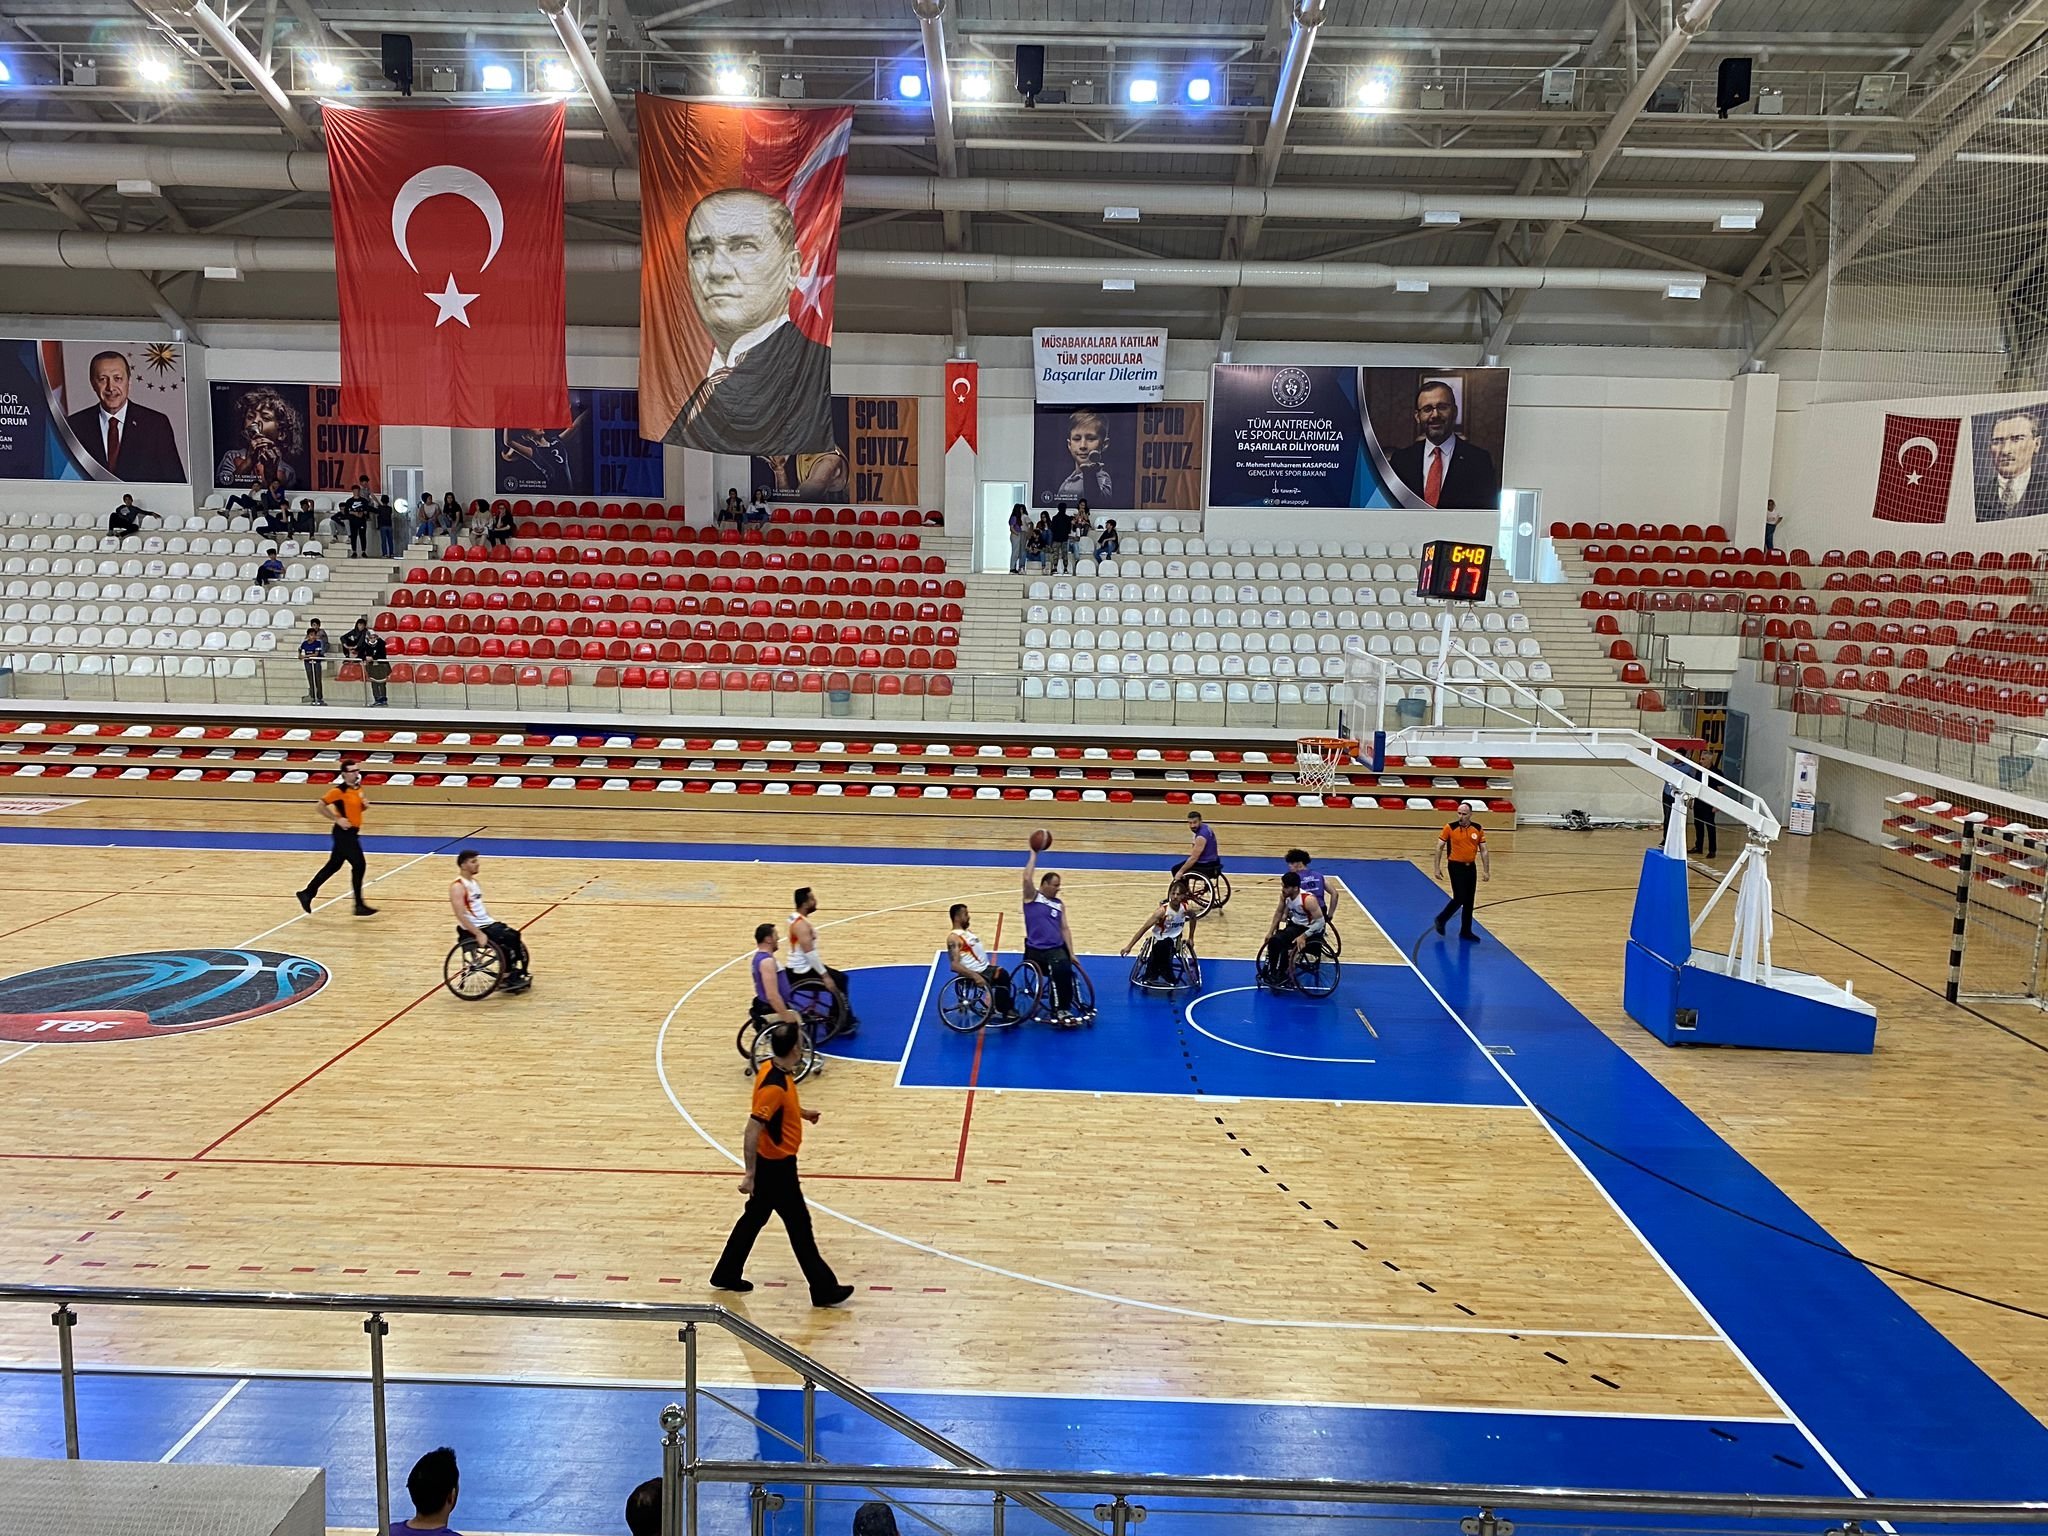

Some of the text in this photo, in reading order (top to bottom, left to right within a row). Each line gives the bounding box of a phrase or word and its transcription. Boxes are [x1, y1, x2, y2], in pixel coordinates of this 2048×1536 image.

[1041, 334, 1159, 348] MÜSABAKALARA KATILAN
[1057, 351, 1143, 365] TÜM SPORCULARA
[1042, 367, 1158, 384] Başarılar Dilerim
[855, 400, 898, 430] SPOR
[1143, 407, 1184, 435] SPOR
[1247, 417, 1333, 430] TÜM ANTRENÖR
[1235, 430, 1344, 441] VE SPORCULARIMIZA
[1238, 441, 1340, 452] BAŞARILAR DİLİYORUM
[1302, 461, 1340, 469] KASAPOĞLU
[1248, 470, 1275, 478] GENÇLİK
[1452, 546, 1485, 565] 6:48
[1450, 567, 1481, 595] 17
[35, 1019, 125, 1033] TBF
